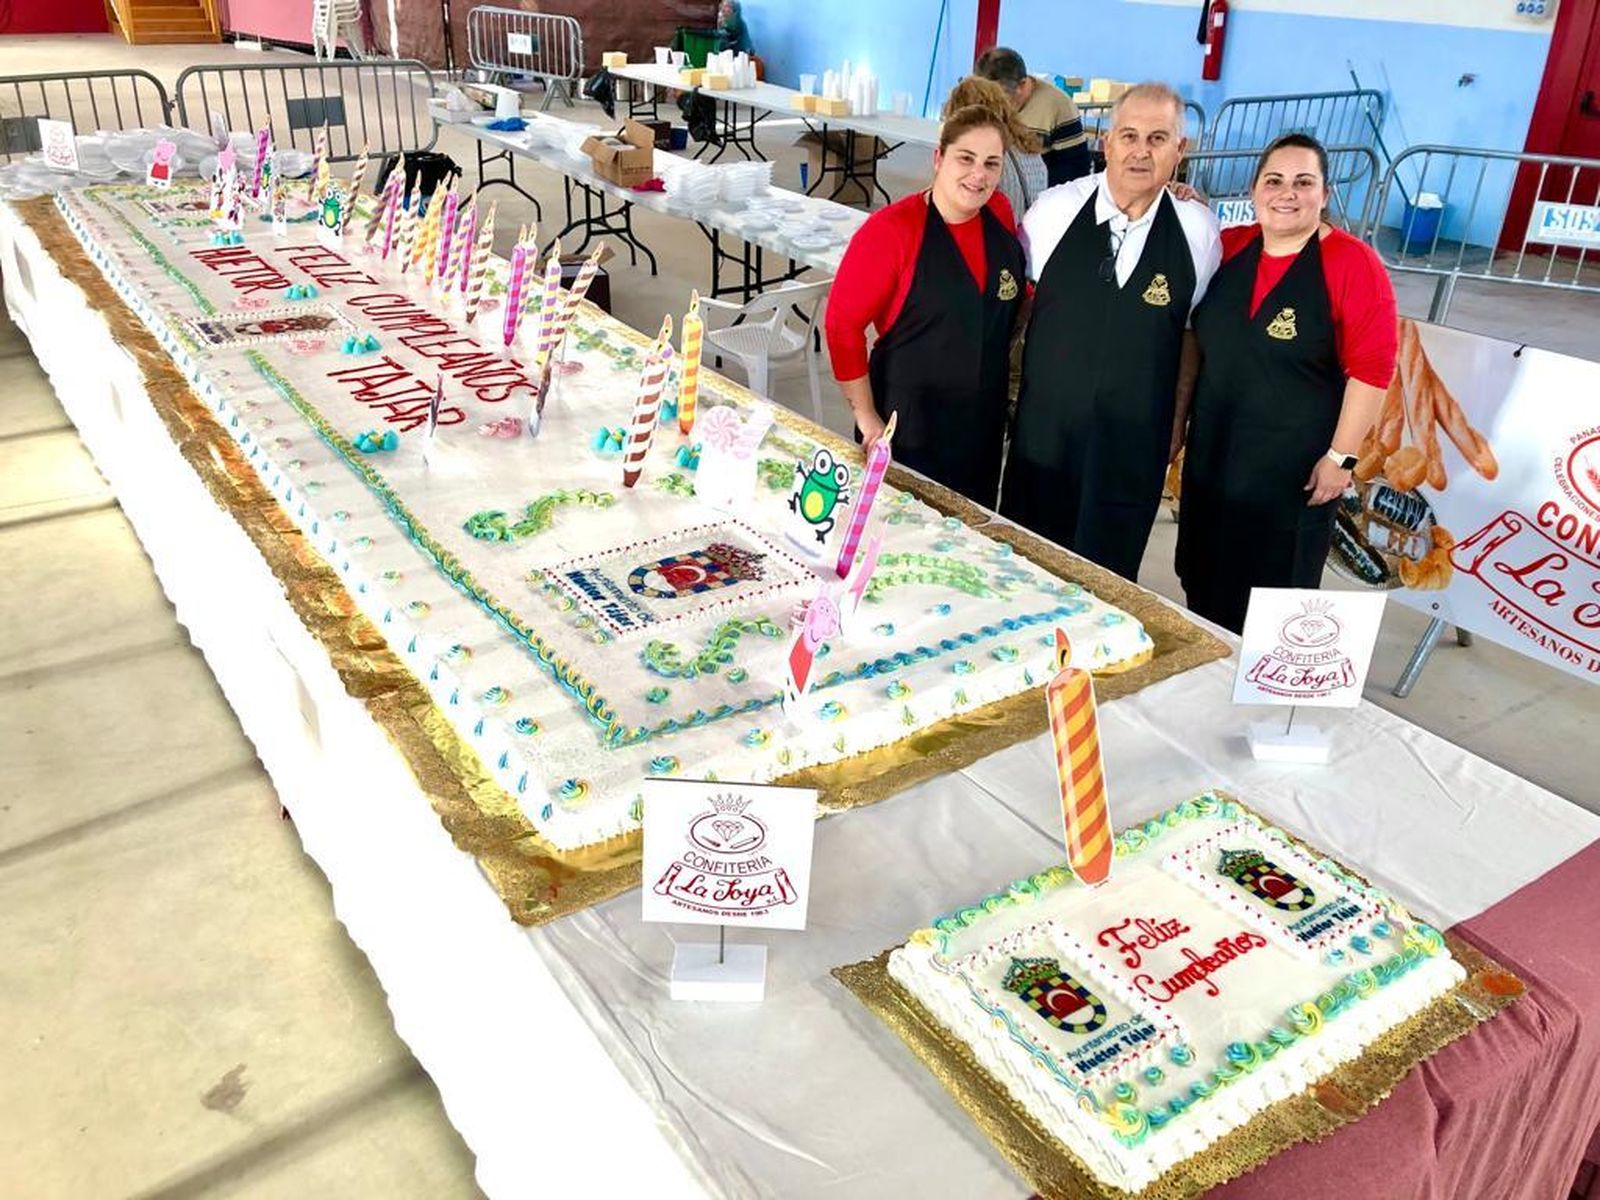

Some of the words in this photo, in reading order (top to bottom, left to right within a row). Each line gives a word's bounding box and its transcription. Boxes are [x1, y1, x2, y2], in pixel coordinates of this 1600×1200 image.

[274, 245, 379, 288] FELIZ
[346, 293, 539, 403] CUMPLEAÑOS
[1569, 425, 1600, 445] PANA
[1536, 501, 1600, 558] CON
[1493, 553, 1569, 607] La
[1489, 600, 1583, 668] ARTESANOS
[1262, 664, 1288, 684] La
[1290, 667, 1340, 689] Joya
[683, 851, 773, 875] CONFITERIA
[674, 874, 707, 898] La
[713, 878, 774, 907] Joya
[1133, 931, 1267, 1003] Cumpleaños
